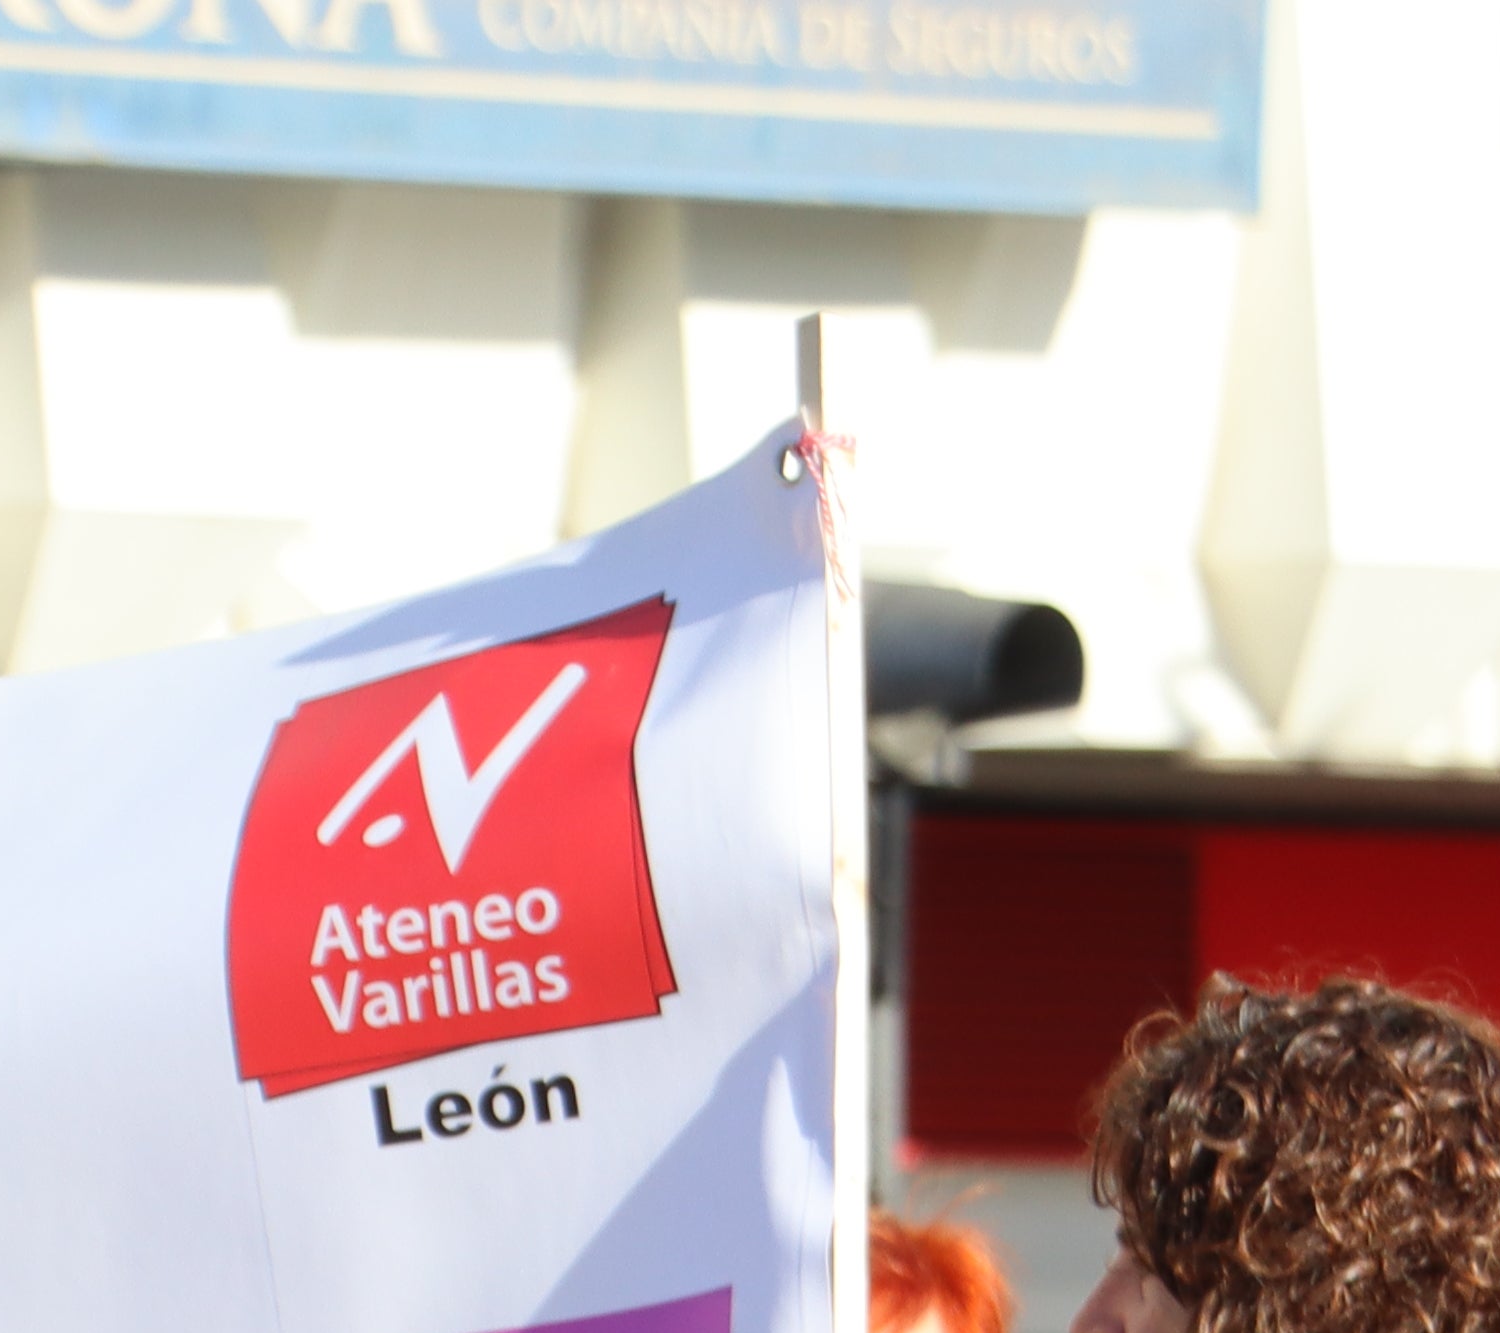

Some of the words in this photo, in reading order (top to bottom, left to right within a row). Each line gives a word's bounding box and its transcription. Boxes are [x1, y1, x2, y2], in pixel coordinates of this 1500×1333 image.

[799, 2, 872, 70] DE
[310, 886, 560, 966] Ateneo
[310, 950, 572, 1033] Varillas
[370, 1064, 581, 1147] León
